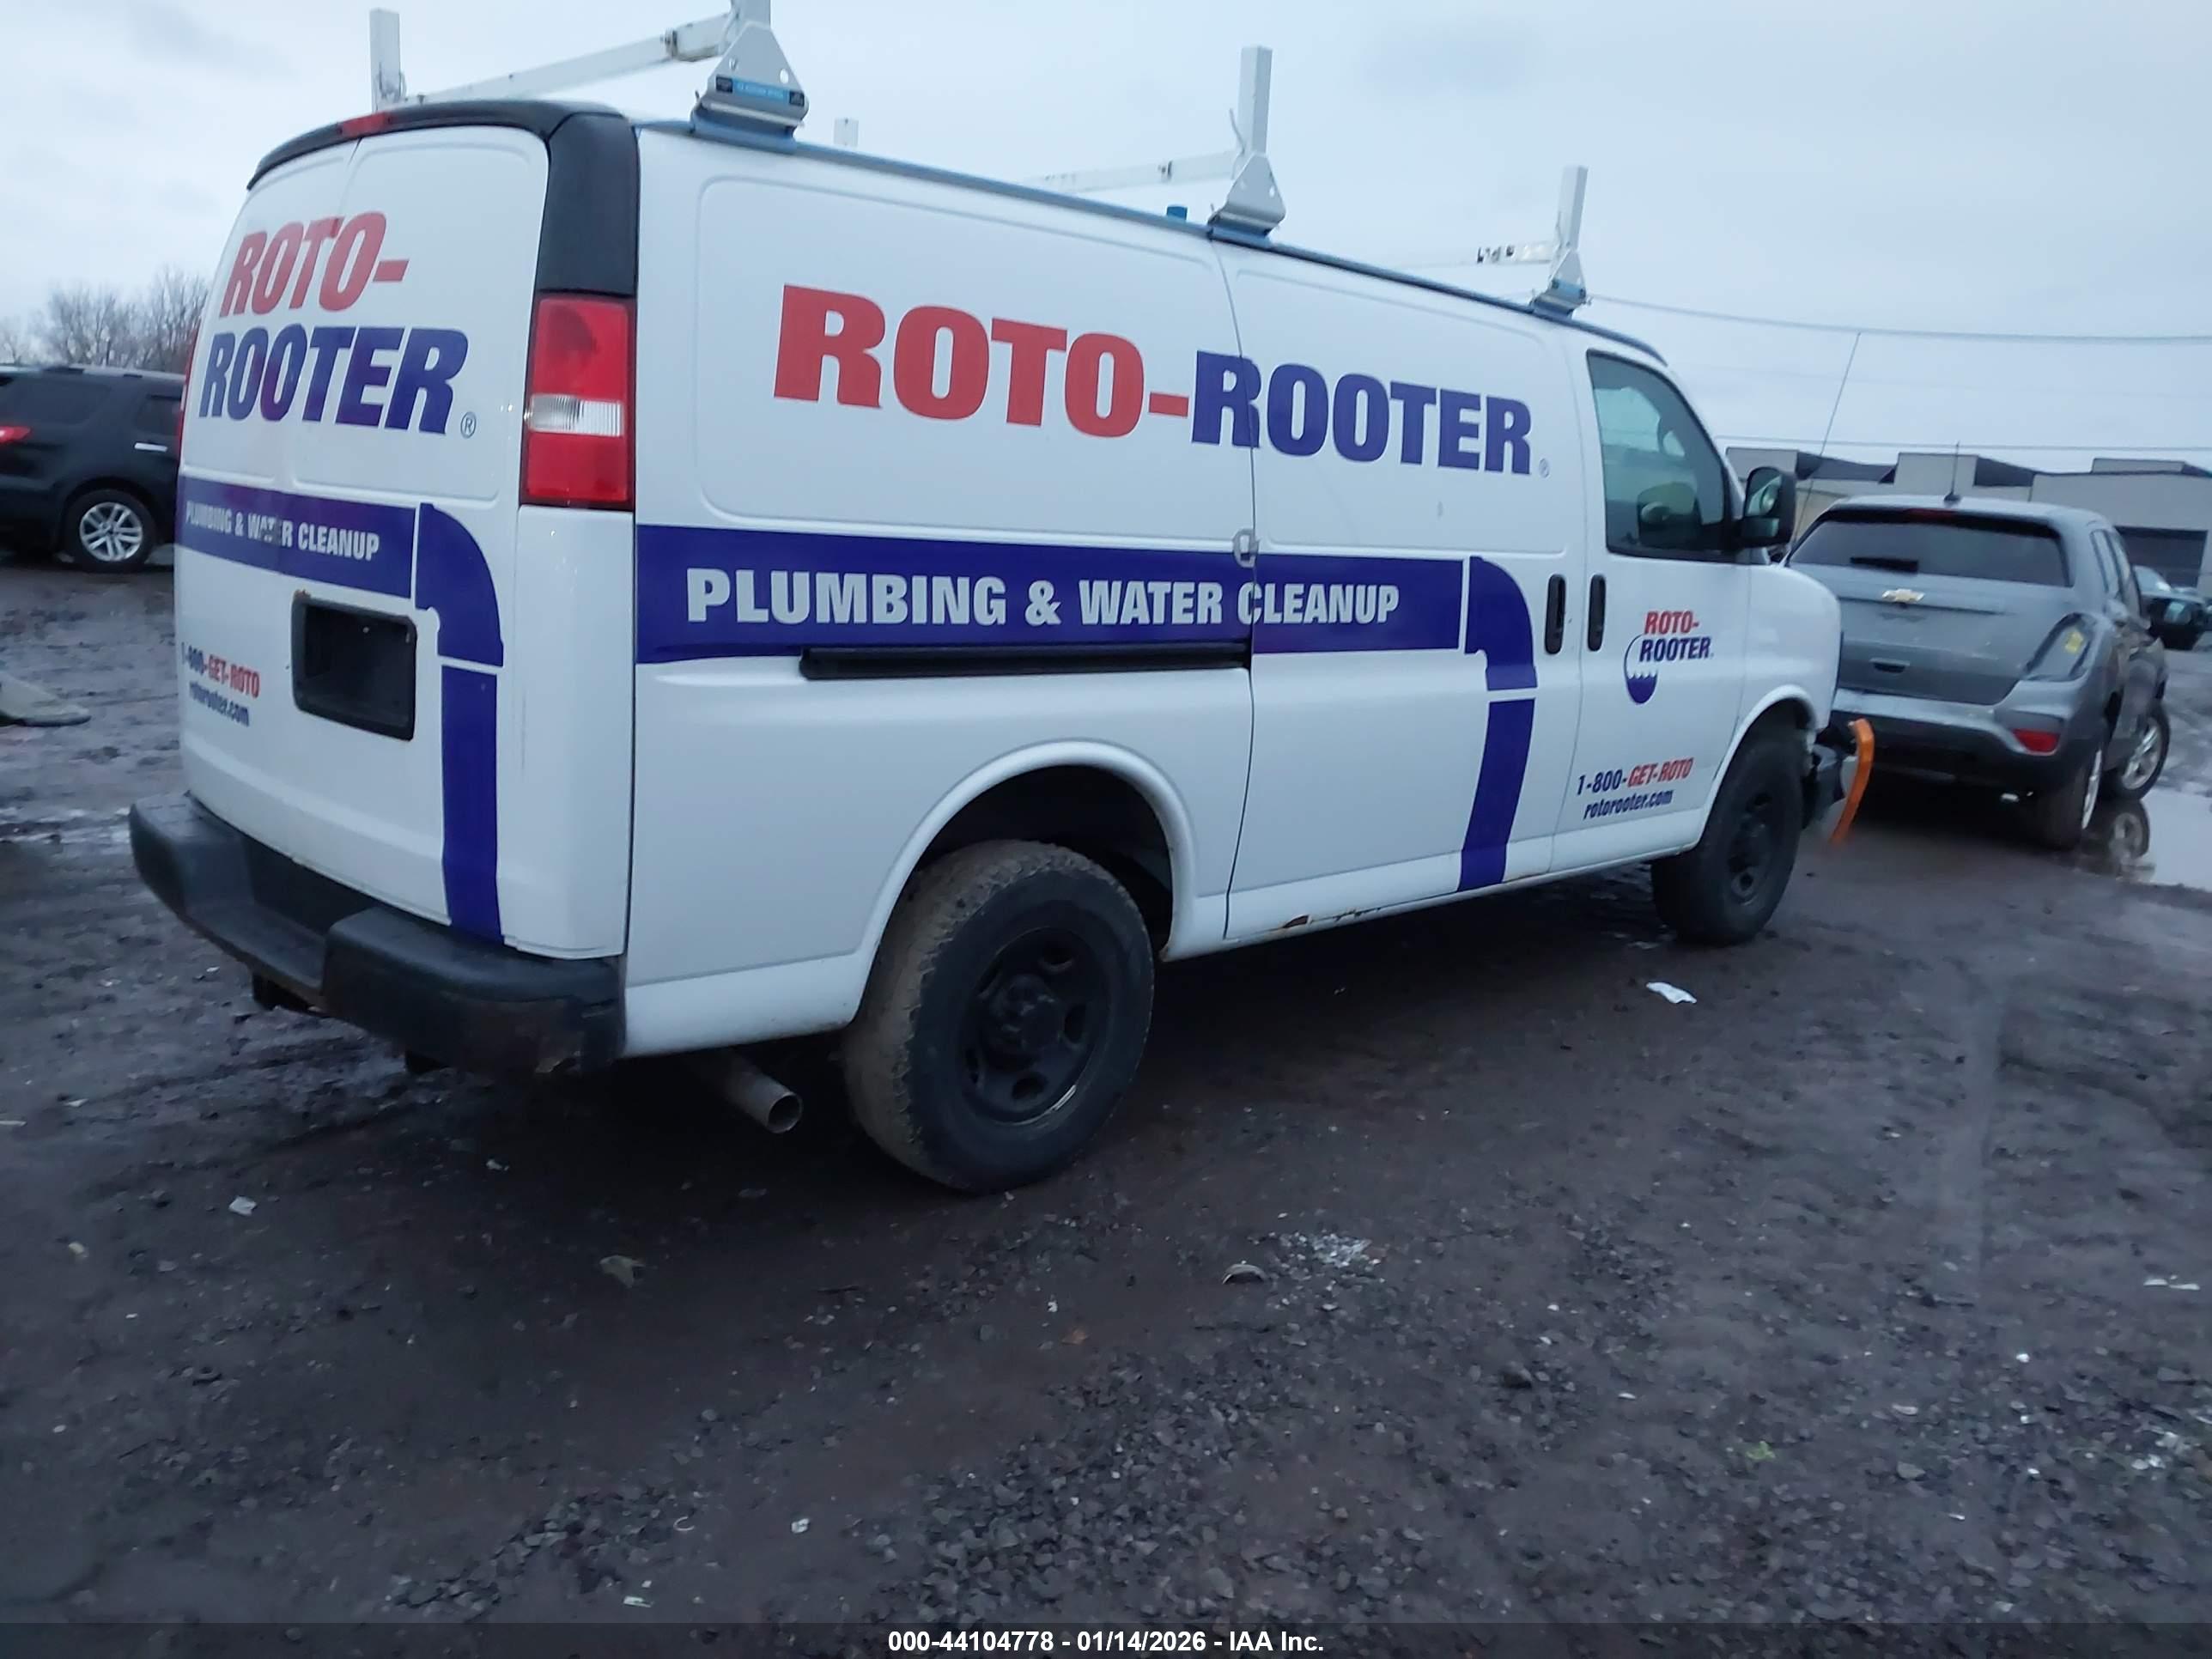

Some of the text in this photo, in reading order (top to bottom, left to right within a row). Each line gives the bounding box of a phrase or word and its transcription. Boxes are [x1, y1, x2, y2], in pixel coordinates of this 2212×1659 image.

[219, 212, 410, 318] ROTO-
[198, 324, 469, 434] ROOTER
[234, 512, 244, 537] &
[298, 522, 380, 562] CLEANUP
[687, 568, 1400, 627] PLUMBING & WATER CLEANUP
[1644, 610, 1699, 635] ROTO-
[1638, 636, 1711, 663] ROOTER
[1577, 757, 1695, 796] 1-800-GET-ROTO
[1583, 789, 1674, 820] rotorooter.com
